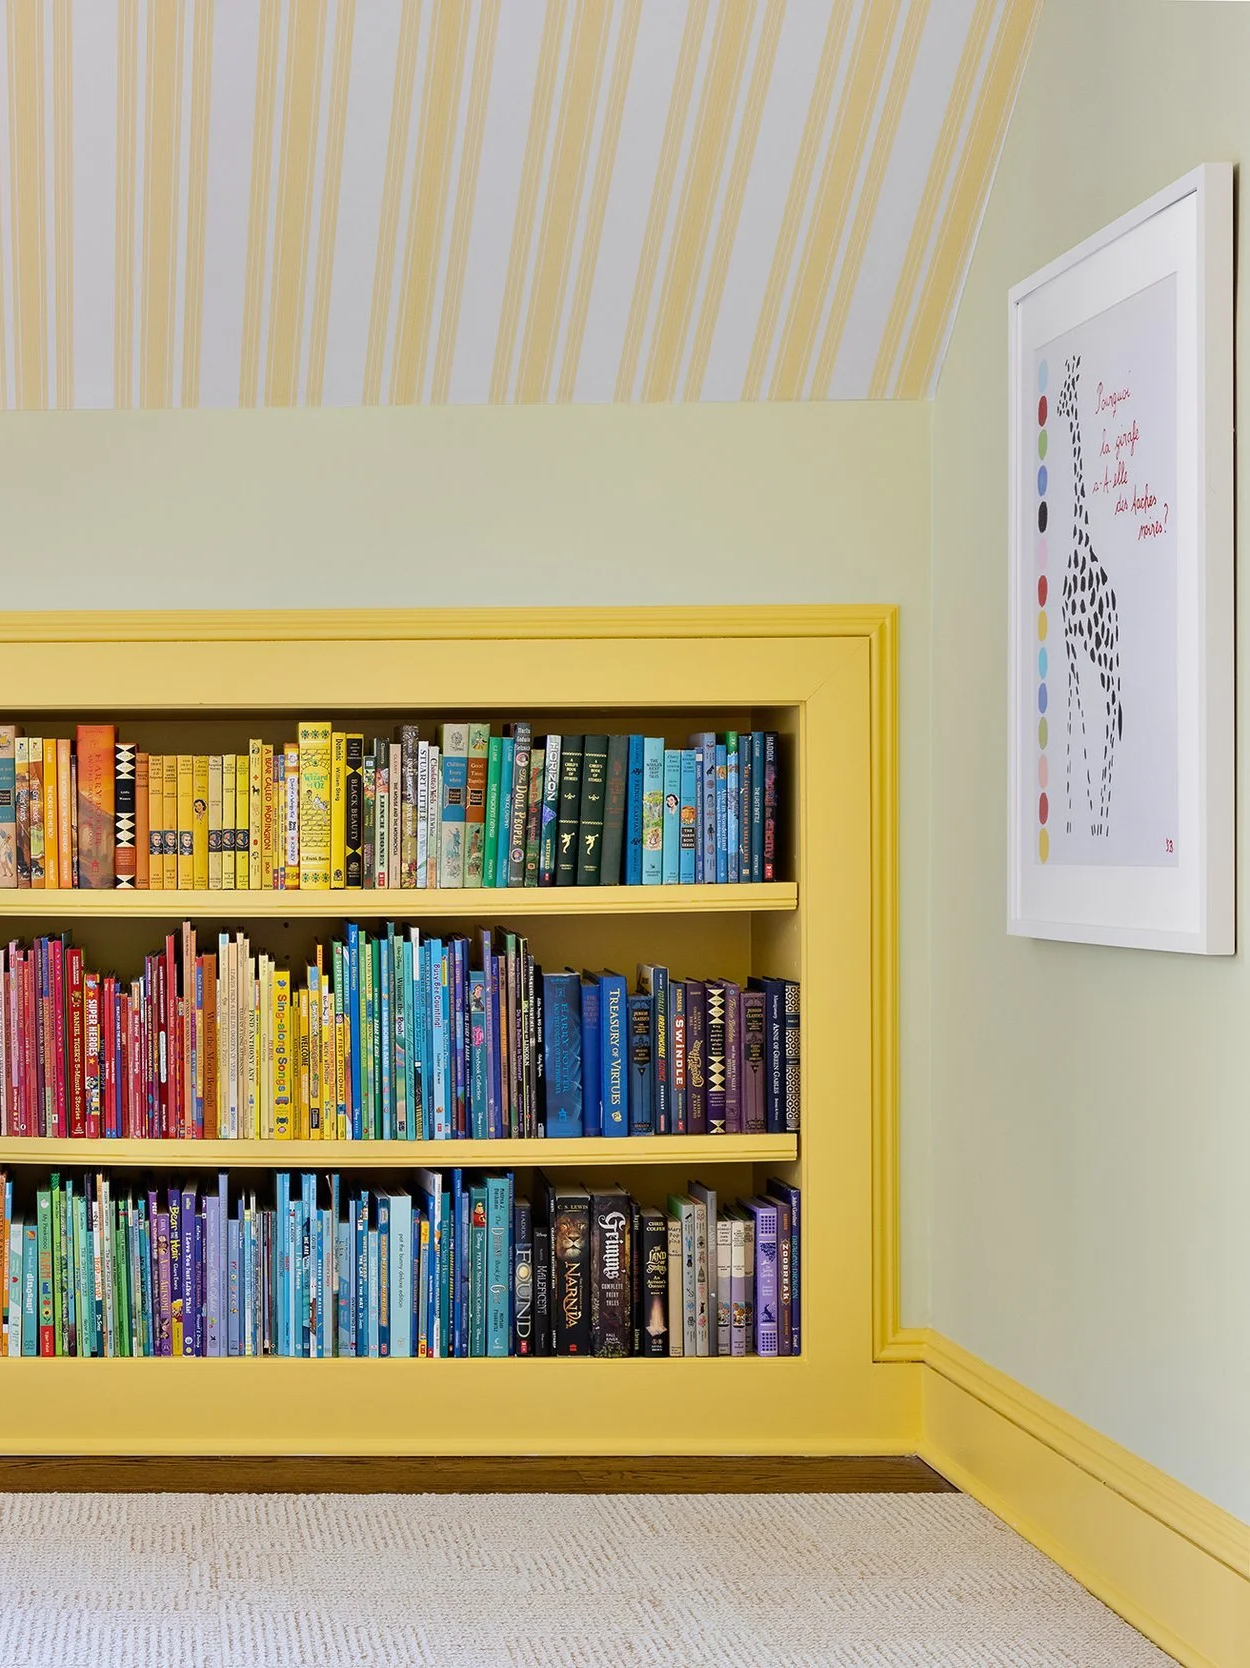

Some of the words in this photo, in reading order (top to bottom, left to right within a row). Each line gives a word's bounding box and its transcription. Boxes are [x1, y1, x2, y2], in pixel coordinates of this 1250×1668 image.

[335, 738, 343, 761] Dominic
[766, 736, 774, 762] HADDIX
[547, 742, 558, 801] HORIZON
[515, 784, 526, 809] DOLL
[512, 812, 526, 846] PEOPLE
[432, 964, 440, 981] Busy
[73, 1011, 81, 1036] DANIEL
[88, 999, 97, 1024] SUPER
[275, 994, 287, 1054] Sing-along
[609, 988, 621, 1046] TREASURY
[89, 1027, 97, 1056] HEROES
[337, 1027, 342, 1037] MY
[658, 1015, 666, 1058] IRRESPONSIBLE
[773, 1042, 780, 1050] OF
[73, 1038, 81, 1062] TIGER'S
[300, 1036, 309, 1066] WELCOME
[612, 1048, 619, 1057] OF
[276, 1057, 287, 1092] Songs
[611, 1058, 621, 1105] VIRTUES
[205, 1076, 214, 1107] Brought
[74, 1097, 82, 1120] Stories
[169, 1206, 180, 1231] Bear
[598, 1211, 626, 1280] Grimm's
[40, 1252, 51, 1279] FARM
[516, 1249, 532, 1338] FOUND
[537, 1265, 548, 1316] MALEFICENT
[563, 1262, 581, 1329] NARNIA
